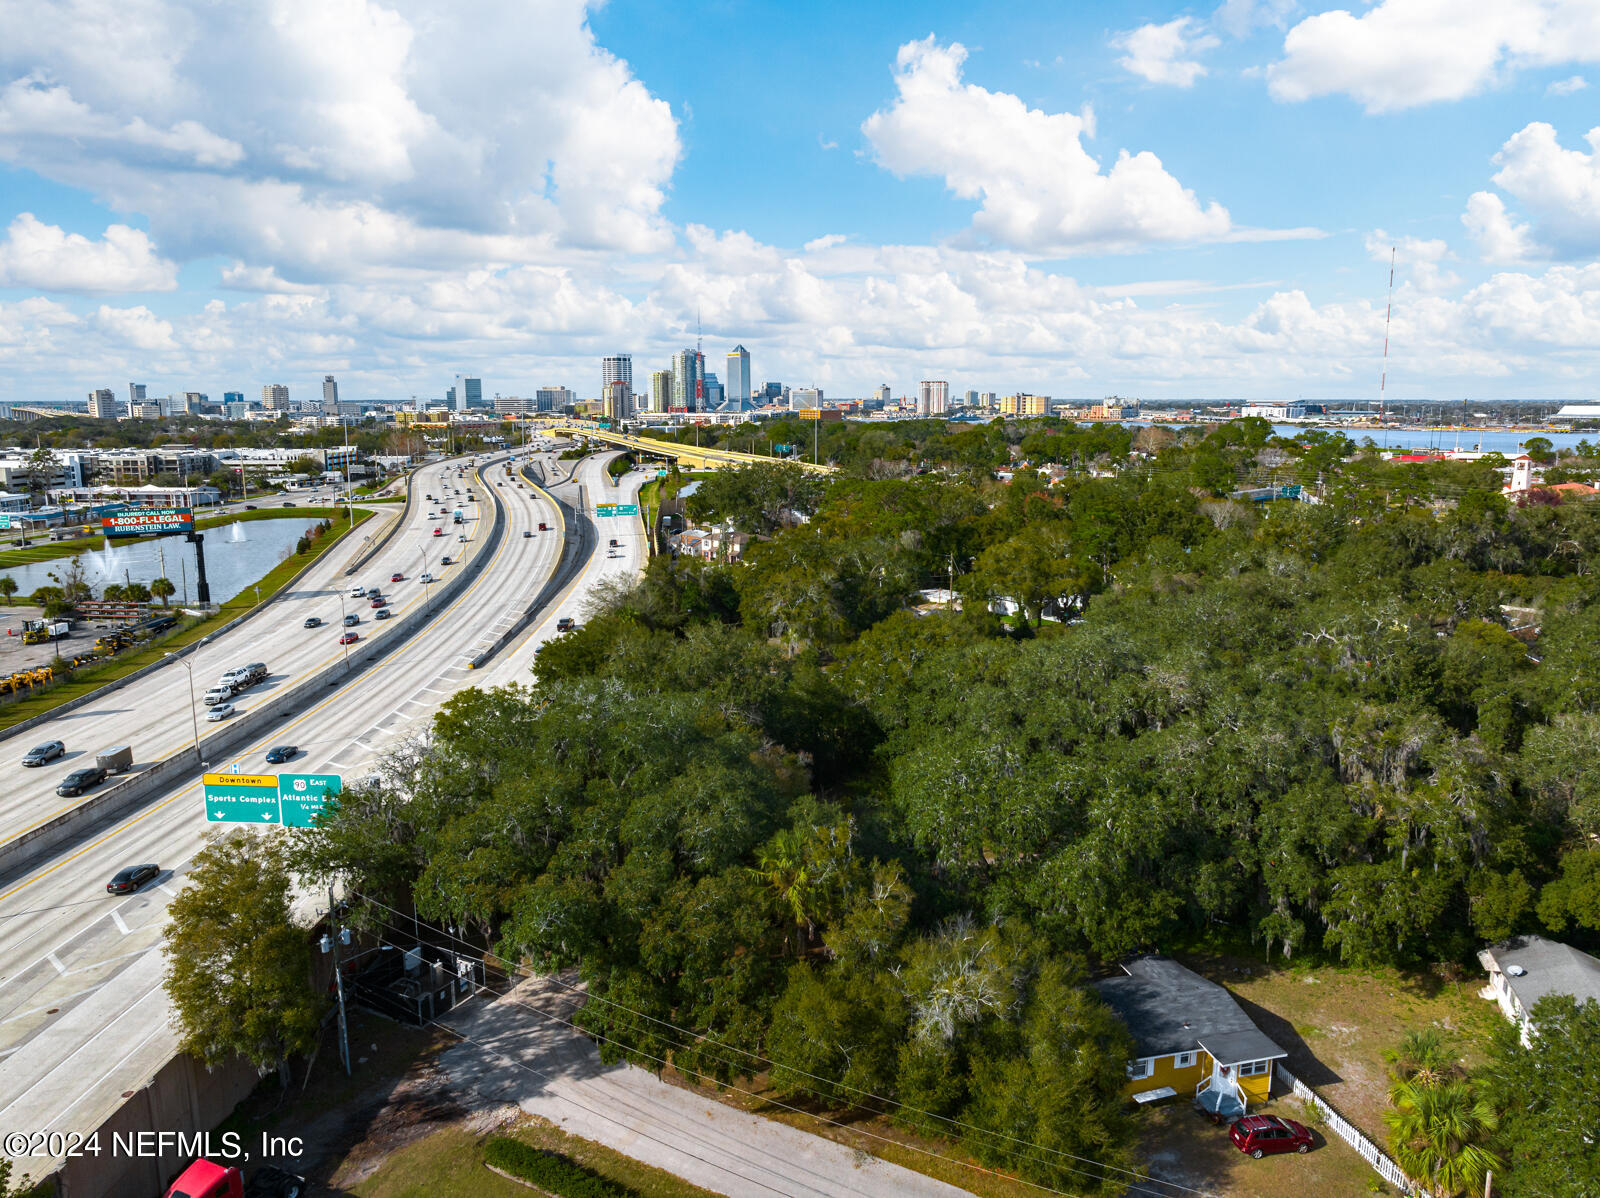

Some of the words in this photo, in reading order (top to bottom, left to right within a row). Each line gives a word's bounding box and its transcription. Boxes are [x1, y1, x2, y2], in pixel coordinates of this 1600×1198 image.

[110, 515, 184, 526] 1-800-FL-LEGAL
[115, 524, 162, 532] RUBENSTEIN
[219, 776, 262, 784] Downtown
[294, 781, 306, 790] 90
[208, 794, 236, 803] Sports
[239, 795, 276, 804] Complex
[282, 794, 318, 802] Atlantic
